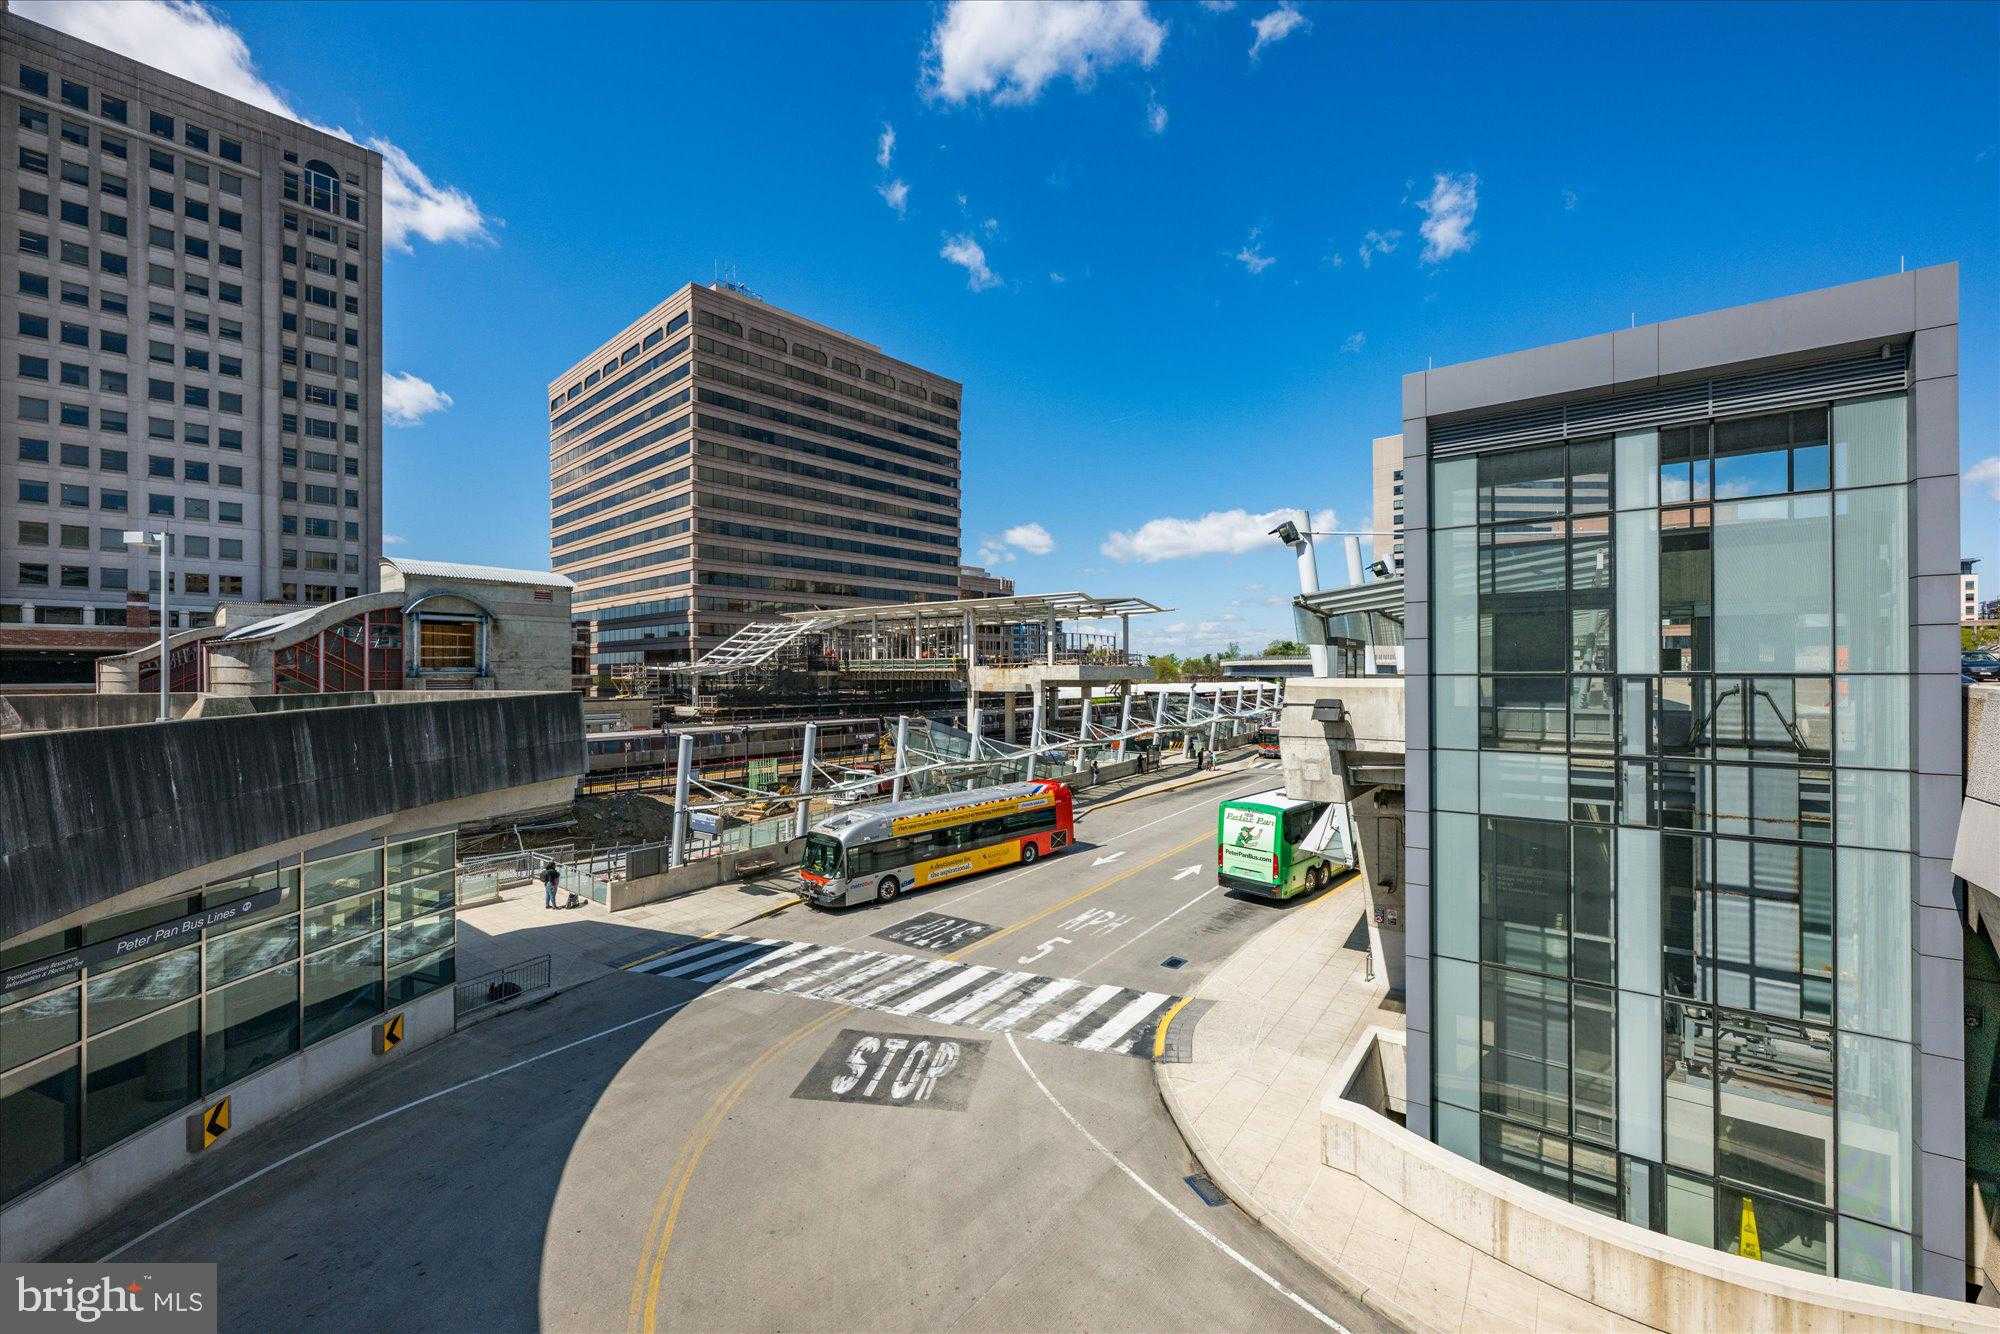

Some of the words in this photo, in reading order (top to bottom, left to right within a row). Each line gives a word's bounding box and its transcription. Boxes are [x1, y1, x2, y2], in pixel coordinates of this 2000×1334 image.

[1225, 848, 1272, 863] PeterPanBus.com
[116, 934, 152, 954] Peter
[154, 926, 179, 942] Pan
[181, 918, 204, 933] Bus
[206, 908, 236, 925] Lines
[1017, 936, 1072, 964] 5
[830, 1036, 960, 1101] STOP
